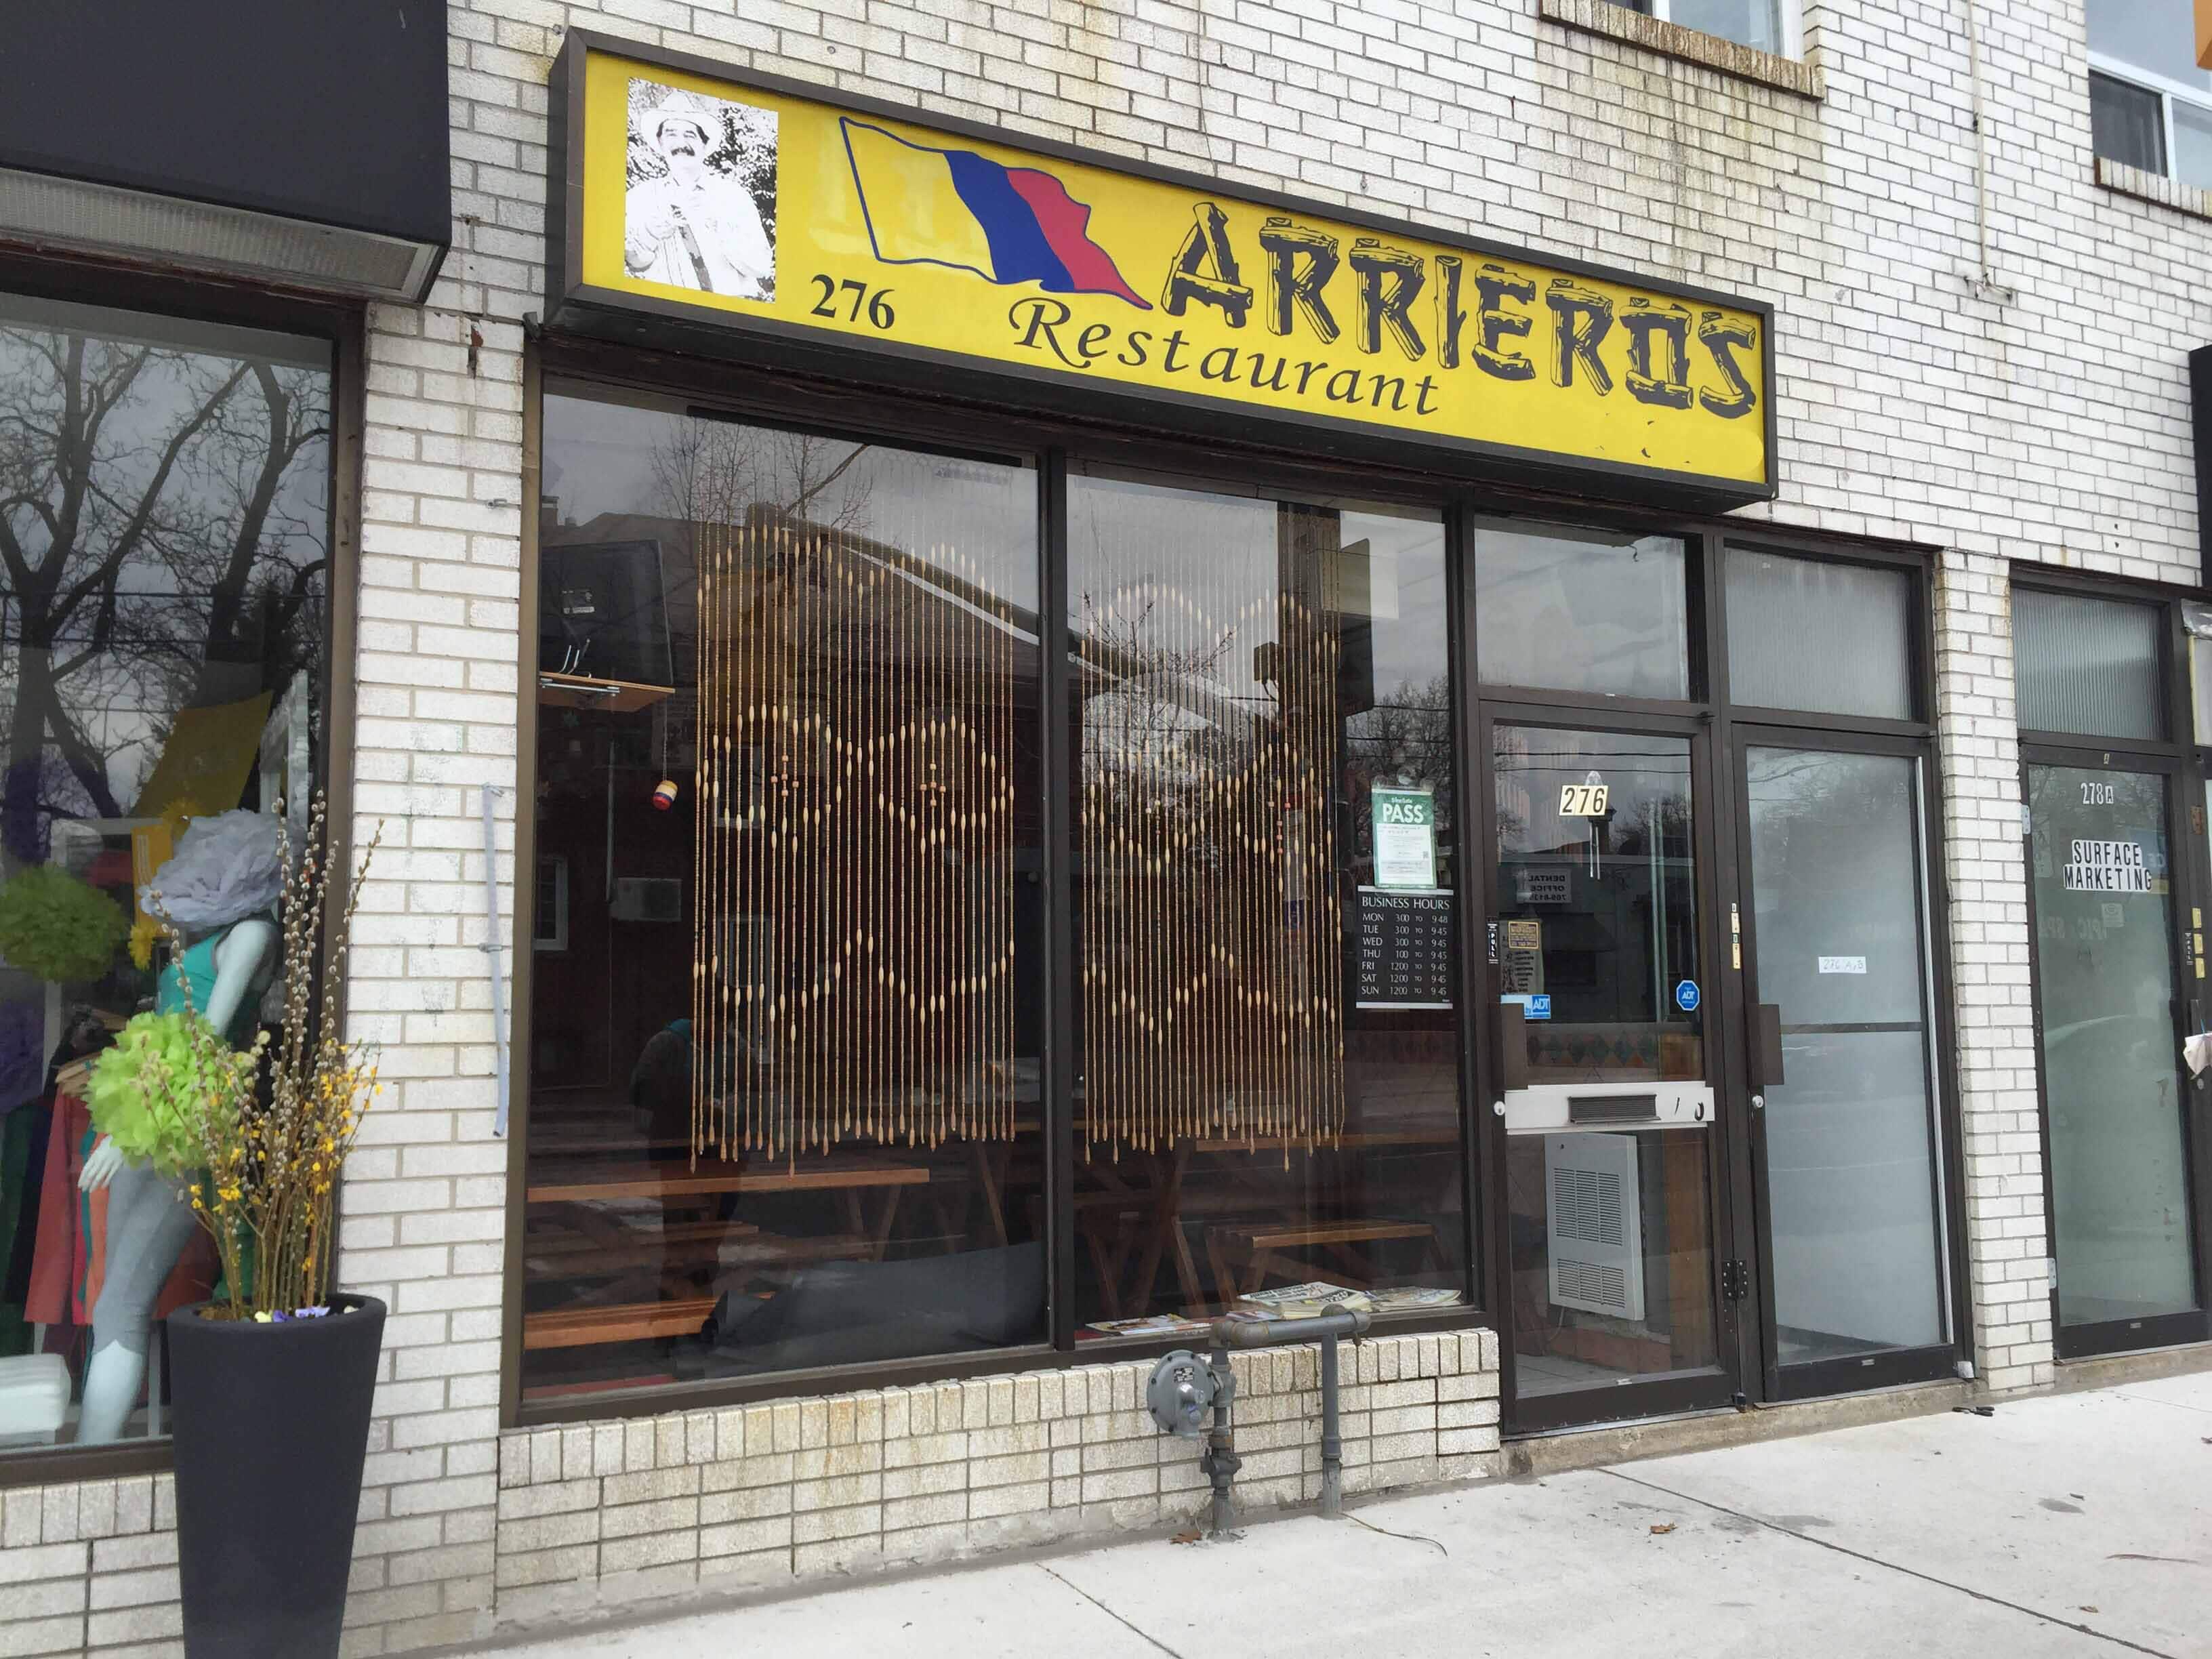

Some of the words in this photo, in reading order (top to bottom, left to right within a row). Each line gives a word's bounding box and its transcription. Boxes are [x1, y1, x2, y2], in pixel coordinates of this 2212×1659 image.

[811, 274, 895, 329] 276
[1160, 201, 1756, 419] ARRIEROS
[1008, 297, 1440, 415] Restaurant
[2081, 782, 2114, 804] 278A
[1562, 787, 1605, 813] 276
[1382, 803, 1424, 823] PASS
[2074, 841, 2141, 866] SURFACE
[2064, 865, 2152, 890] MARKETING
[1362, 896, 1410, 909] BUSINESS
[1414, 898, 1450, 910] HOURS
[1362, 912, 1384, 922] MON
[1363, 924, 1379, 934] TUE
[1362, 937, 1383, 946] WED
[1363, 949, 1381, 958] THU
[1361, 961, 1375, 970] FRI
[1361, 973, 1377, 983] SAT
[1361, 985, 1380, 995] SUN
[1681, 991, 1695, 1000] ADT
[1534, 998, 1549, 1010] ADT
